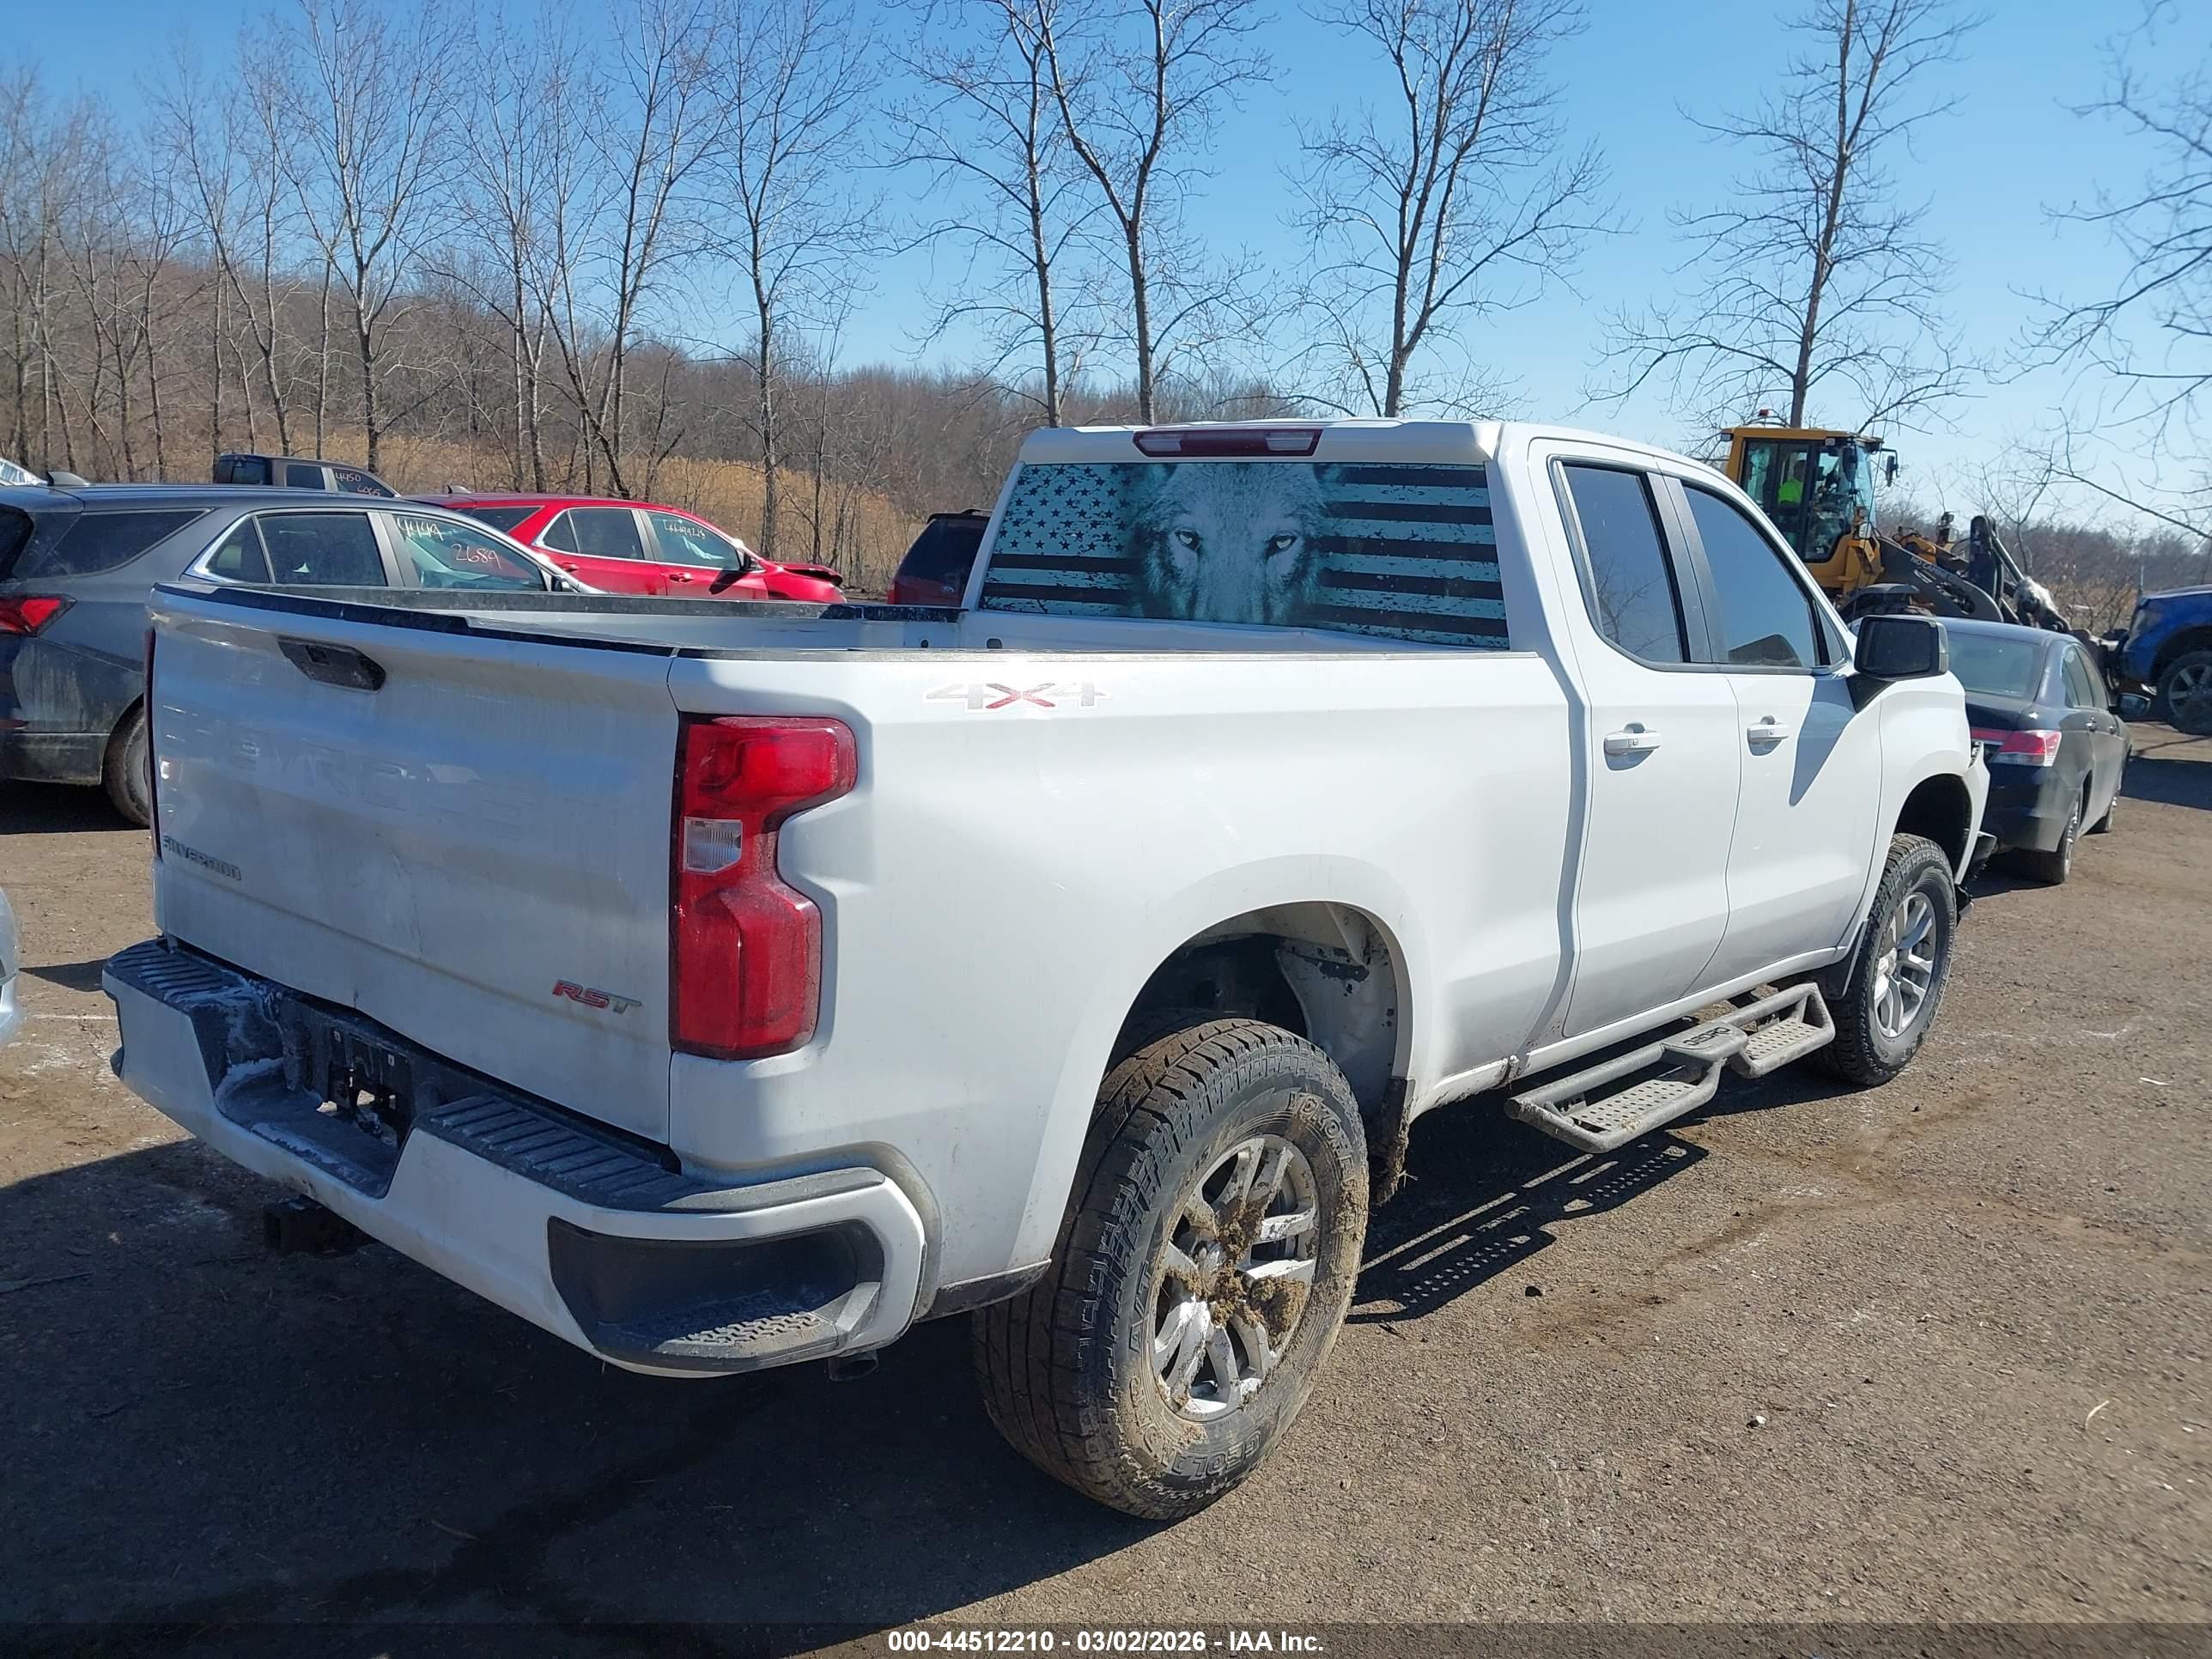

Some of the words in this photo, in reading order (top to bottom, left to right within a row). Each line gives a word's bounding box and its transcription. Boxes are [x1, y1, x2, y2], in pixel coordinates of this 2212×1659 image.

[335, 471, 362, 482] 4450
[398, 516, 444, 541] 4449
[451, 543, 501, 570] 2689
[162, 835, 242, 881] SILVERADO
[552, 979, 642, 1015] RST
